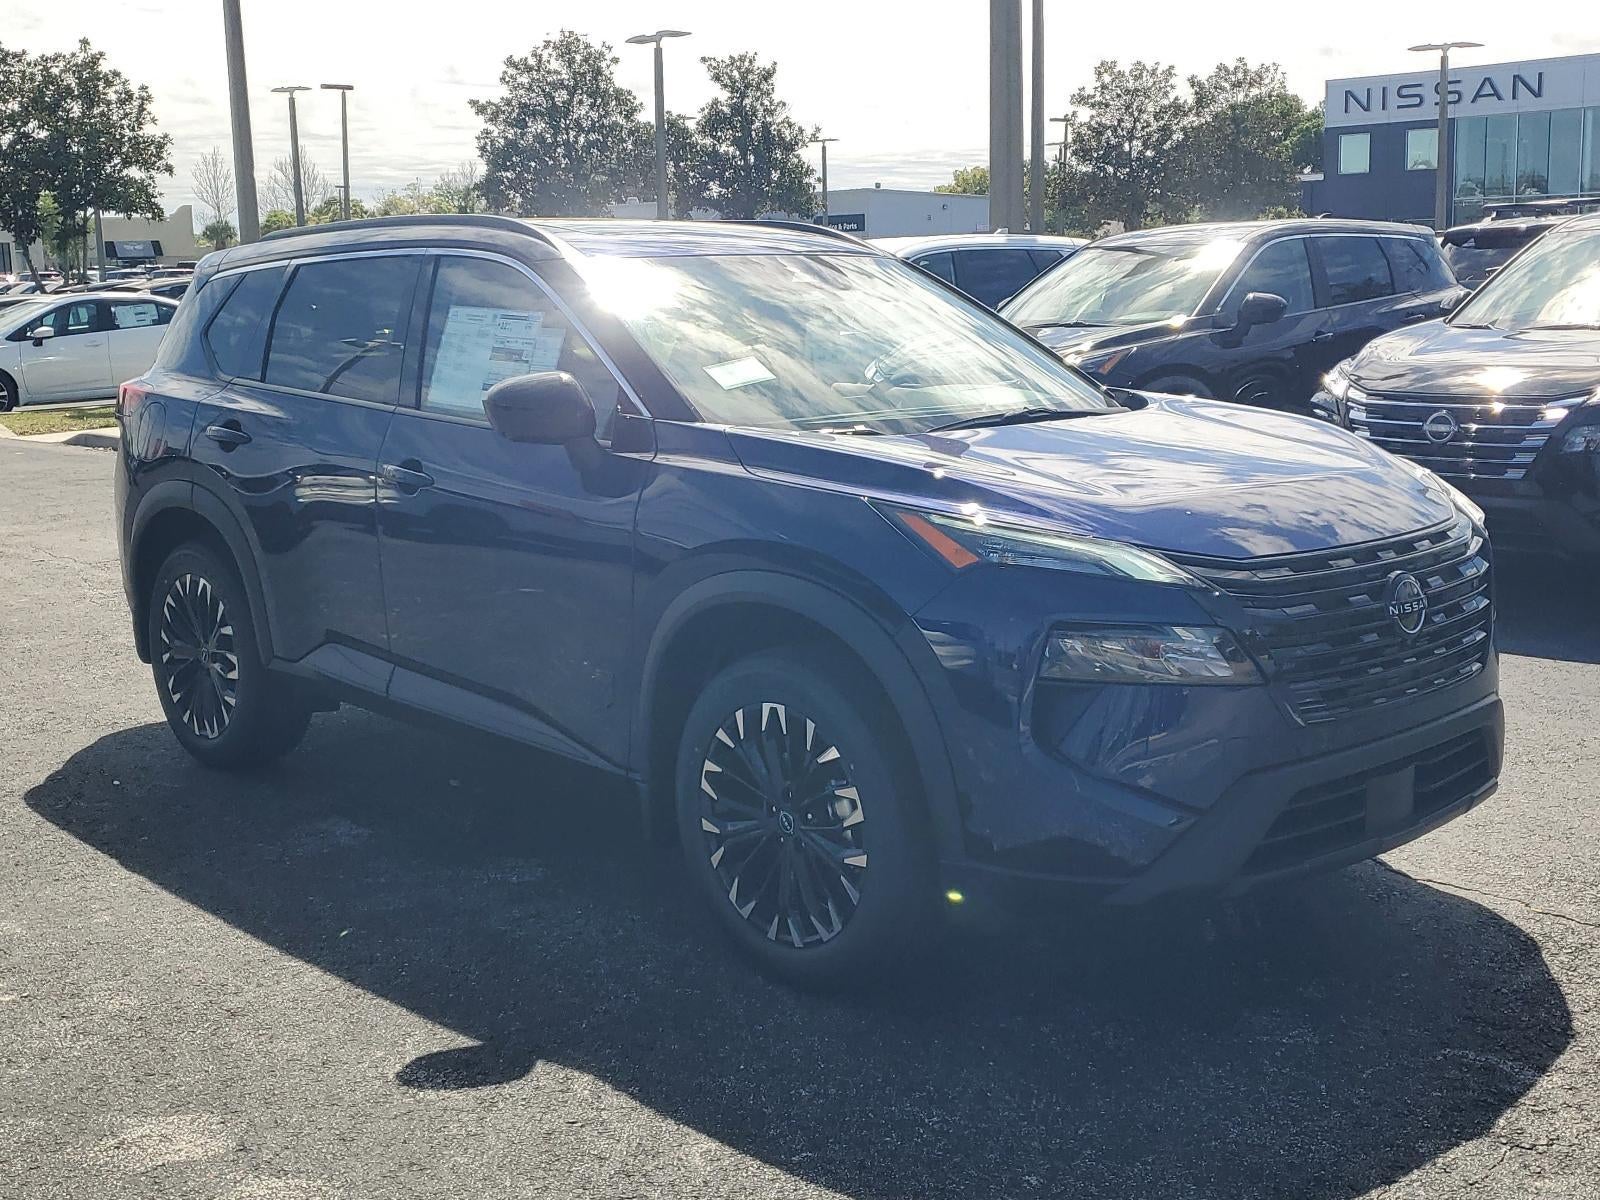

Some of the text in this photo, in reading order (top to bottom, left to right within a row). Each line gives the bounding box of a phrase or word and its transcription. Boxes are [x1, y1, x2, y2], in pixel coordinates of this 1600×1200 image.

[1344, 72, 1544, 114] NISSAN
[843, 222, 858, 230] Parts
[1389, 599, 1427, 616] NISSA
